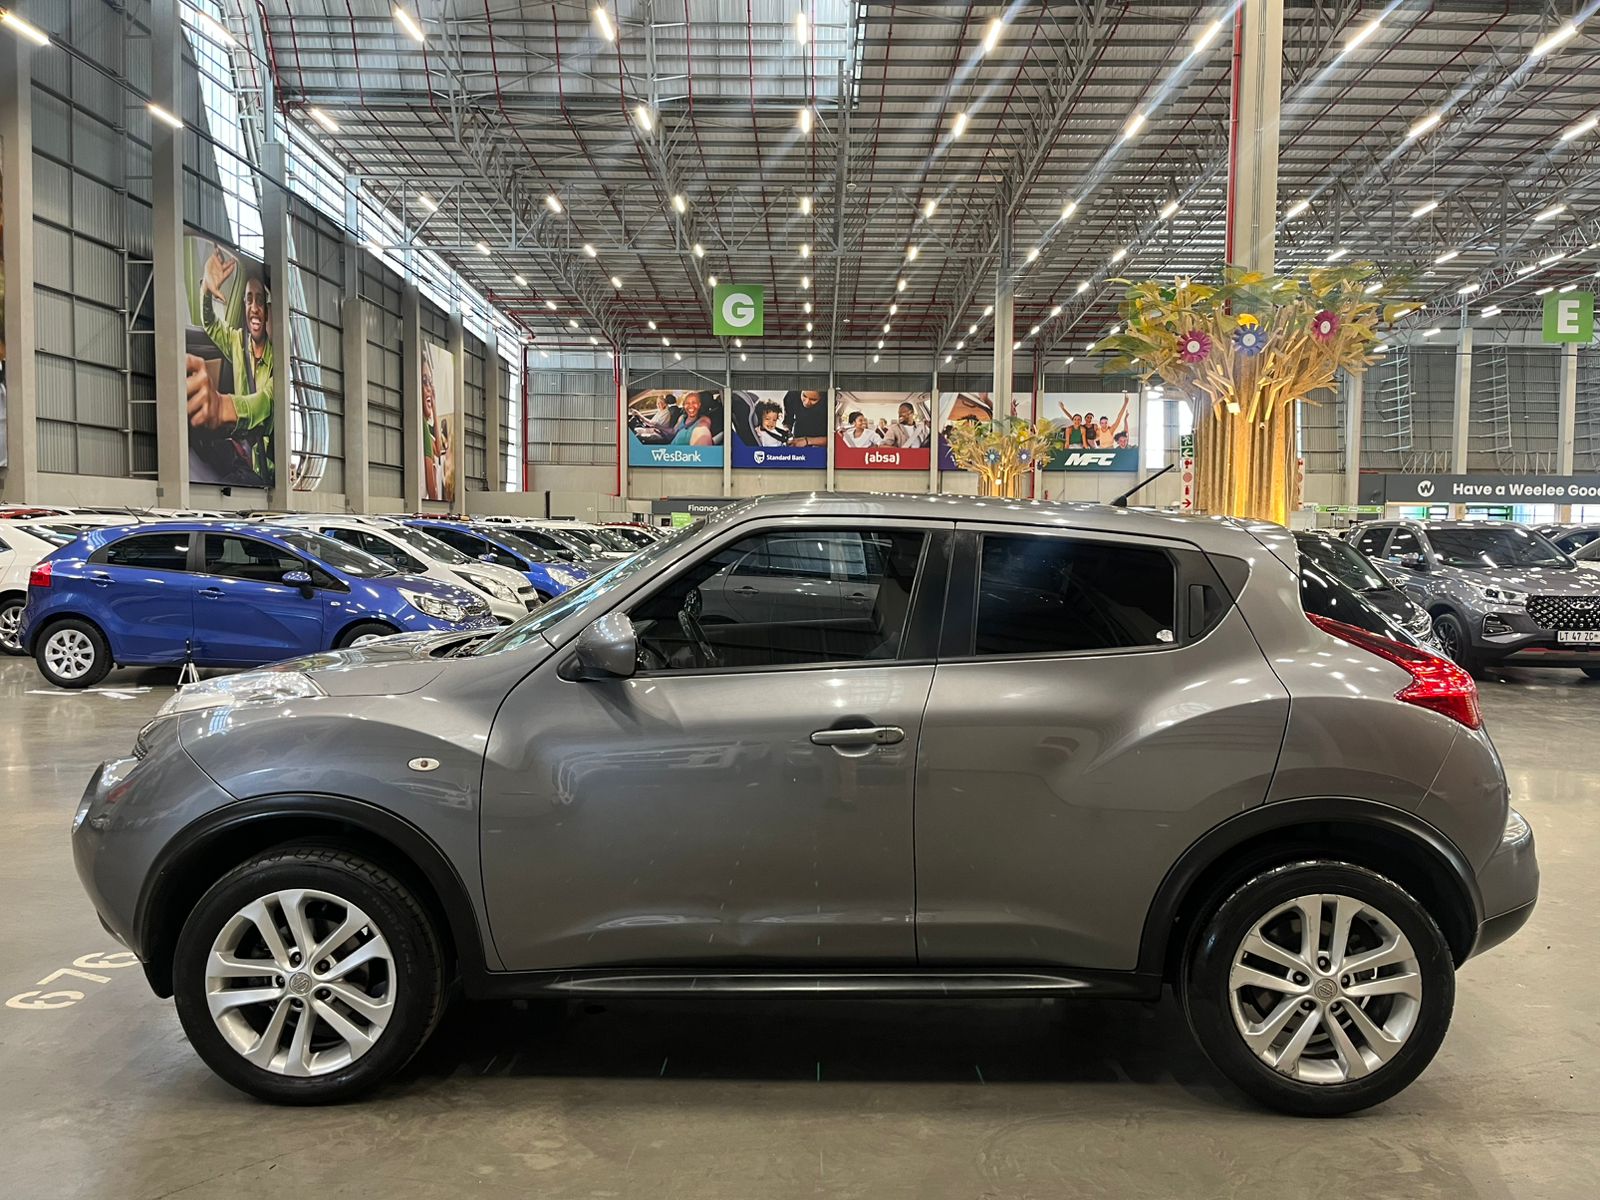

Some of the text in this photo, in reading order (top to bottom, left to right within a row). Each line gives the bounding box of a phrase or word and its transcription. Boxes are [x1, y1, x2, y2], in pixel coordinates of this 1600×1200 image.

[722, 293, 755, 328] G
[1557, 299, 1580, 334] E
[651, 448, 702, 463] WesBank
[864, 452, 900, 465] (absa)
[1064, 452, 1117, 467] MFC
[1452, 482, 1493, 496] Have
[1495, 485, 1506, 496] a
[1509, 483, 1565, 497] Weelee
[687, 504, 719, 512] Finance
[1560, 632, 1568, 640] LT
[1572, 632, 1582, 640] 47
[5, 951, 140, 1009] 676
